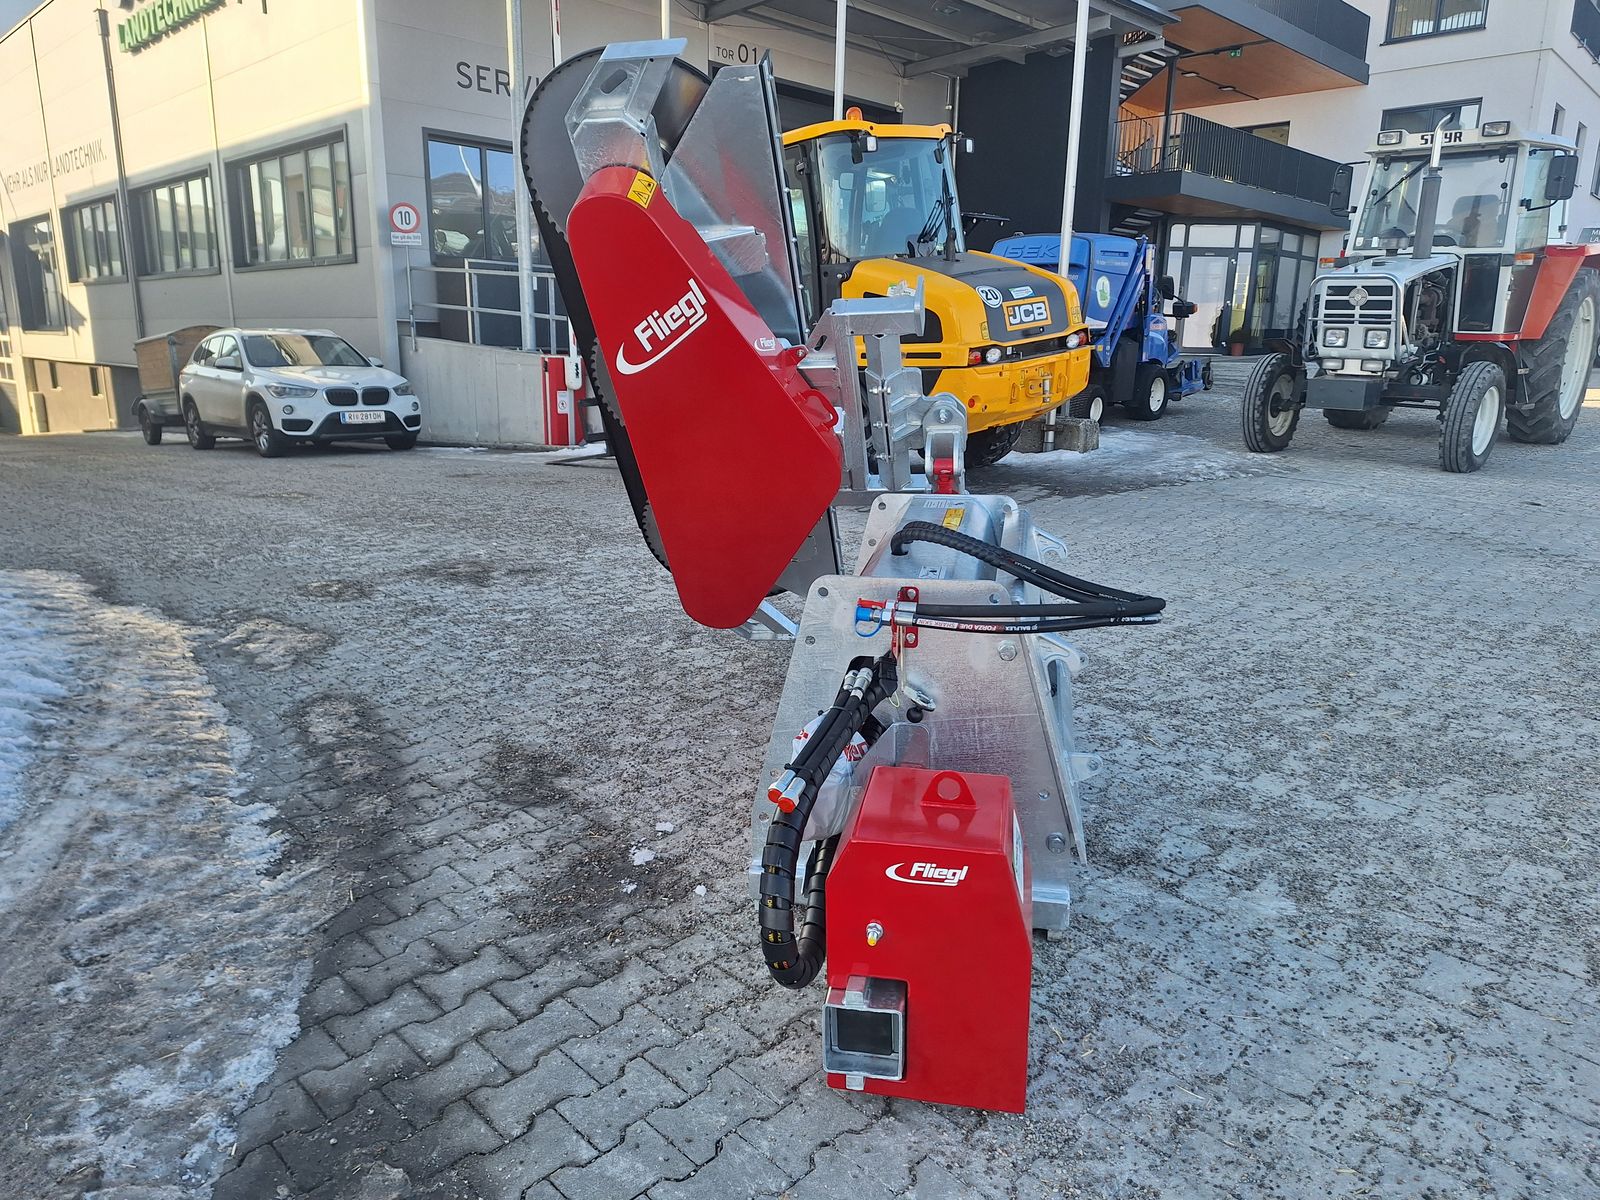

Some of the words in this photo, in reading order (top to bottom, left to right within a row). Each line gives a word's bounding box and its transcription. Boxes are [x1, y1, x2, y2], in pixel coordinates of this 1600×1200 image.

[716, 46, 734, 60] TOR
[738, 44, 757, 64] 01
[1420, 131, 1462, 145] STYR
[34, 161, 49, 183] NUR
[398, 210, 411, 225] 10
[981, 289, 998, 301] 20
[634, 278, 707, 352] Fliegl
[1010, 302, 1047, 325] JCB
[910, 862, 969, 883] Fliegl
